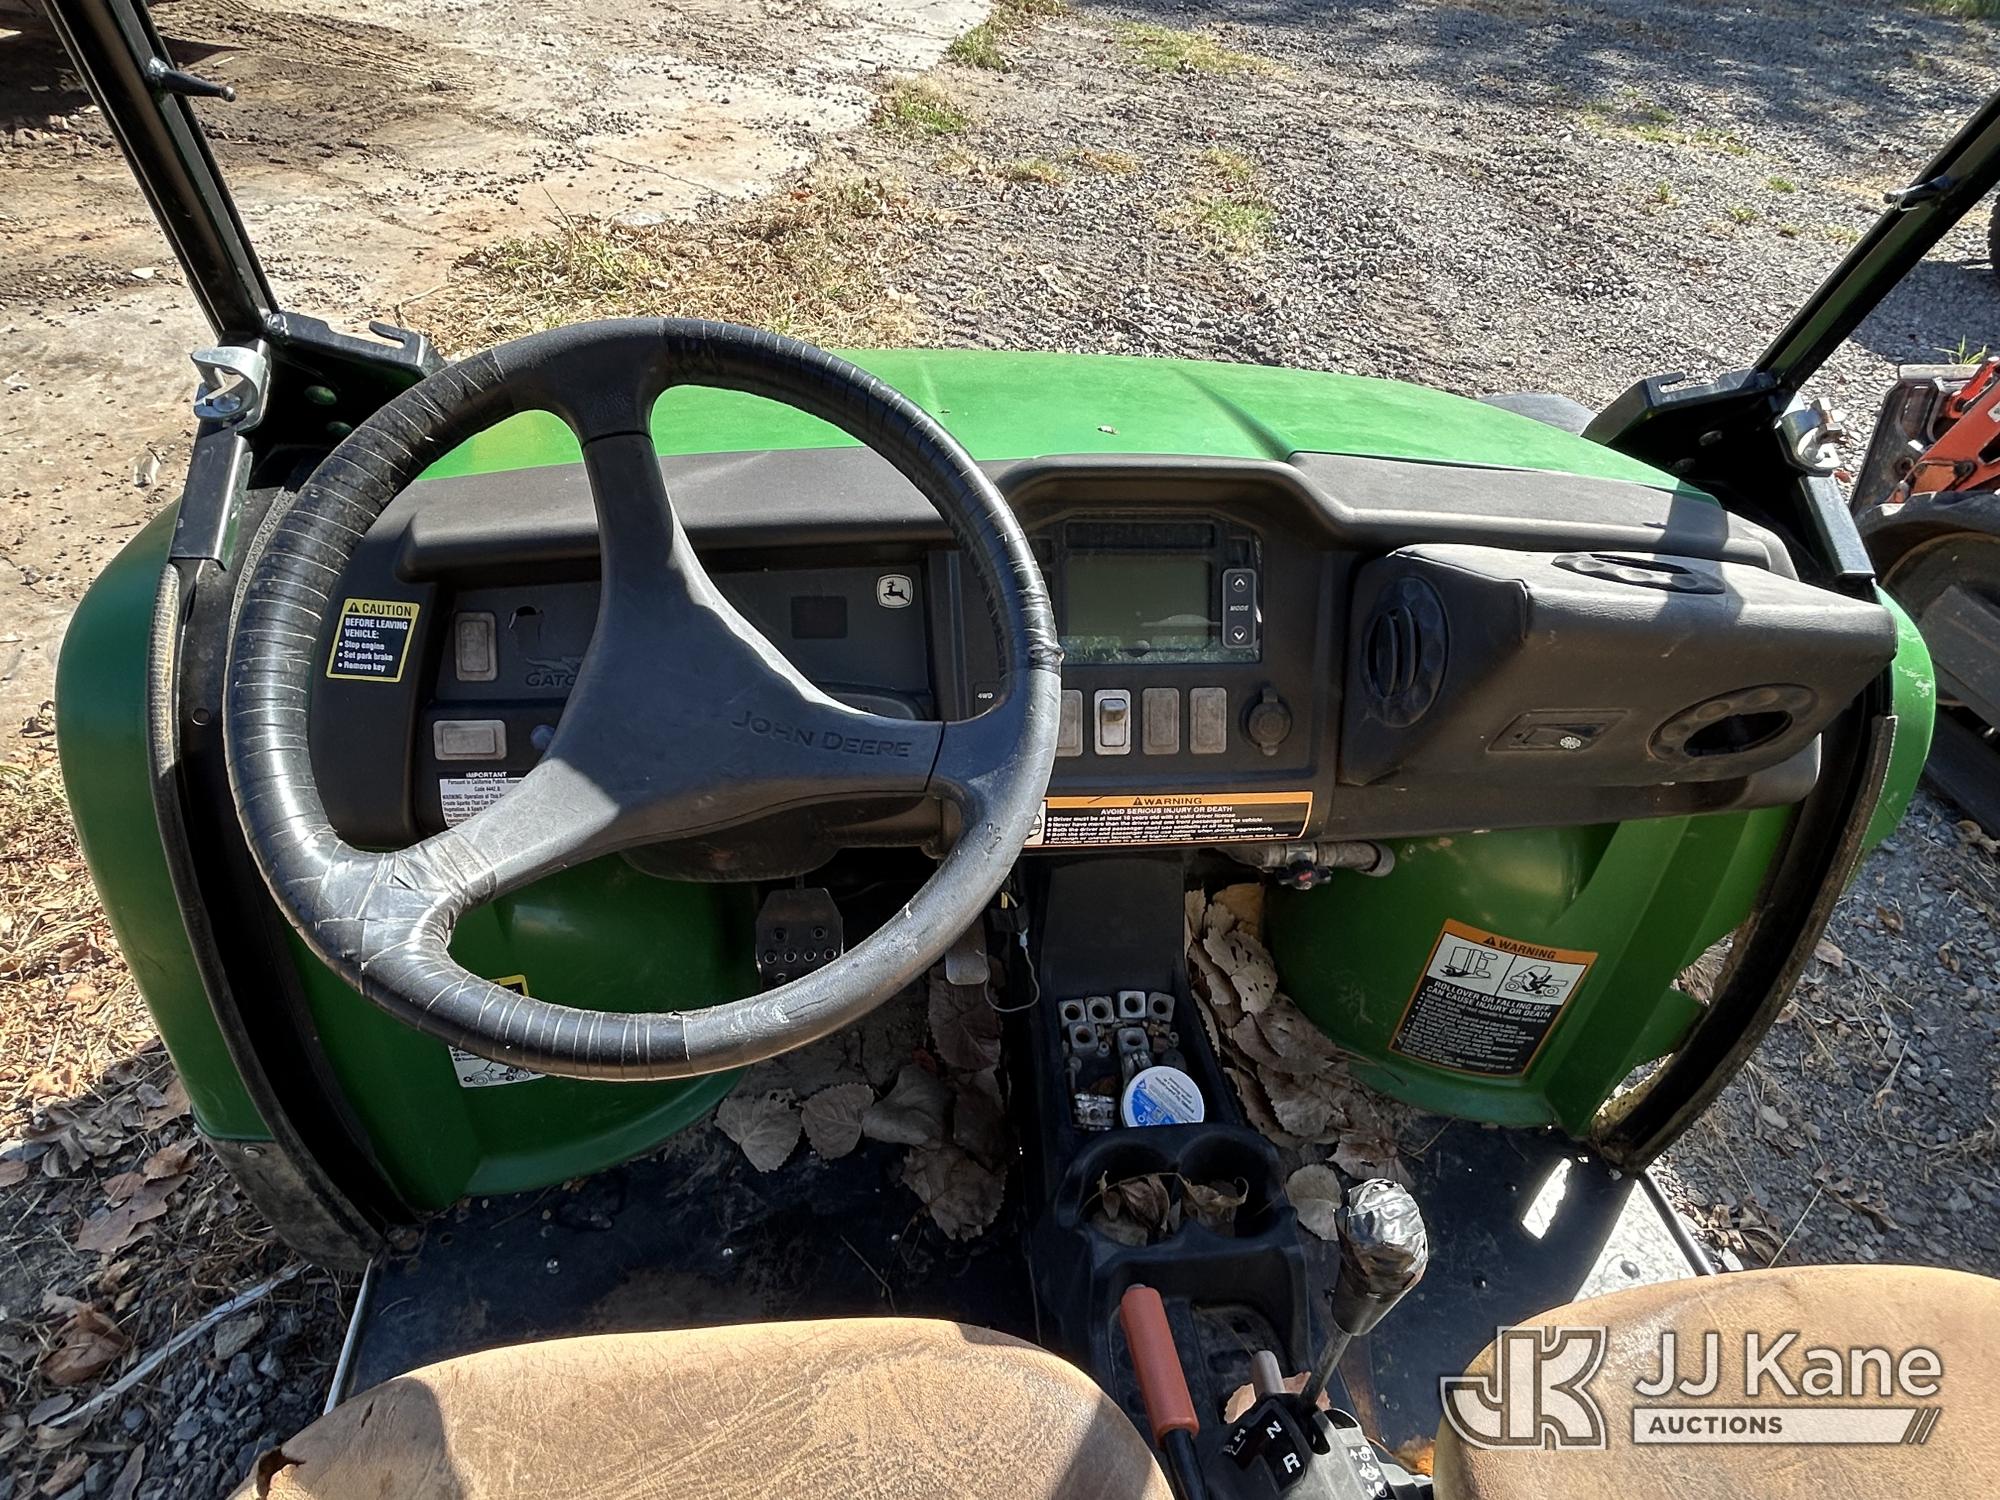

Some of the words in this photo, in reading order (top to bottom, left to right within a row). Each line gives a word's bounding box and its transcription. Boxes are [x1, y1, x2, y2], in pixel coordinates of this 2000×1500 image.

[362, 603, 411, 616] CAUTION
[345, 618, 375, 628] BEFORE
[376, 619, 408, 630] LEAVING
[344, 629, 379, 639] VEHICLE:
[344, 640, 360, 649] Stop
[361, 642, 385, 650] engine
[344, 651, 356, 659] Set
[357, 652, 372, 660] park
[374, 652, 393, 661] brake
[344, 661, 372, 670] Remove
[373, 663, 385, 672] key
[526, 672, 576, 687] GATO
[731, 711, 816, 746] JOHN
[822, 731, 912, 758] DEERE
[1144, 797, 1202, 806] WARNING
[1164, 806, 1192, 814] INJURY
[1498, 939, 1556, 959] WARNING
[1426, 985, 1443, 996] CAN
[1446, 992, 1473, 1006] CAUSE
[1476, 999, 1507, 1013] INJURY
[1508, 1007, 1521, 1015] OR
[1523, 1009, 1551, 1018] DEATH
[1434, 980, 1480, 1000] ROLLOVER
[1481, 994, 1495, 1003] OR
[1496, 996, 1532, 1010] FALLING
[1533, 1003, 1551, 1011] OFF
[1266, 1420, 1282, 1440] N
[1282, 1452, 1301, 1474] R
